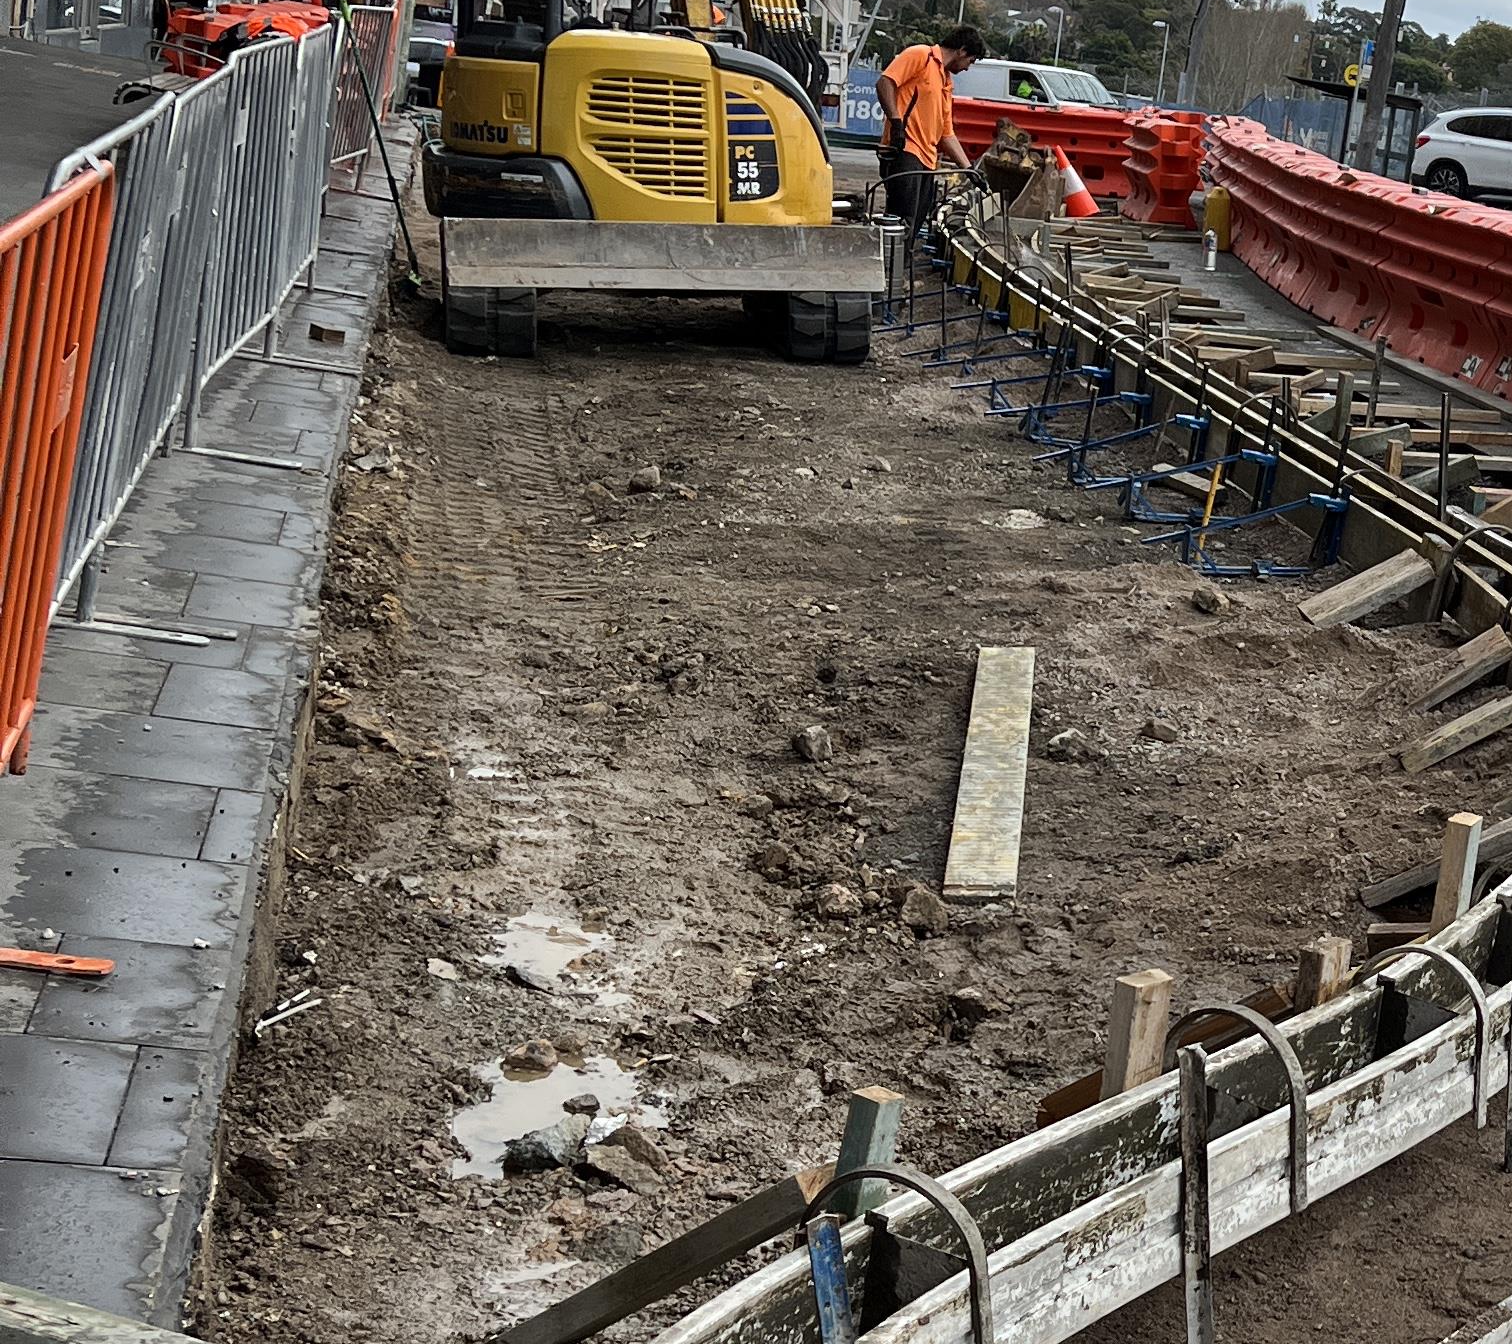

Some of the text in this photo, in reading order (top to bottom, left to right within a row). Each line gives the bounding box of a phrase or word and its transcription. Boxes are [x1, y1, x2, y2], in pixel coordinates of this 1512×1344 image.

[734, 145, 755, 160] PC
[737, 161, 759, 179] 55
[736, 181, 762, 195] MR
